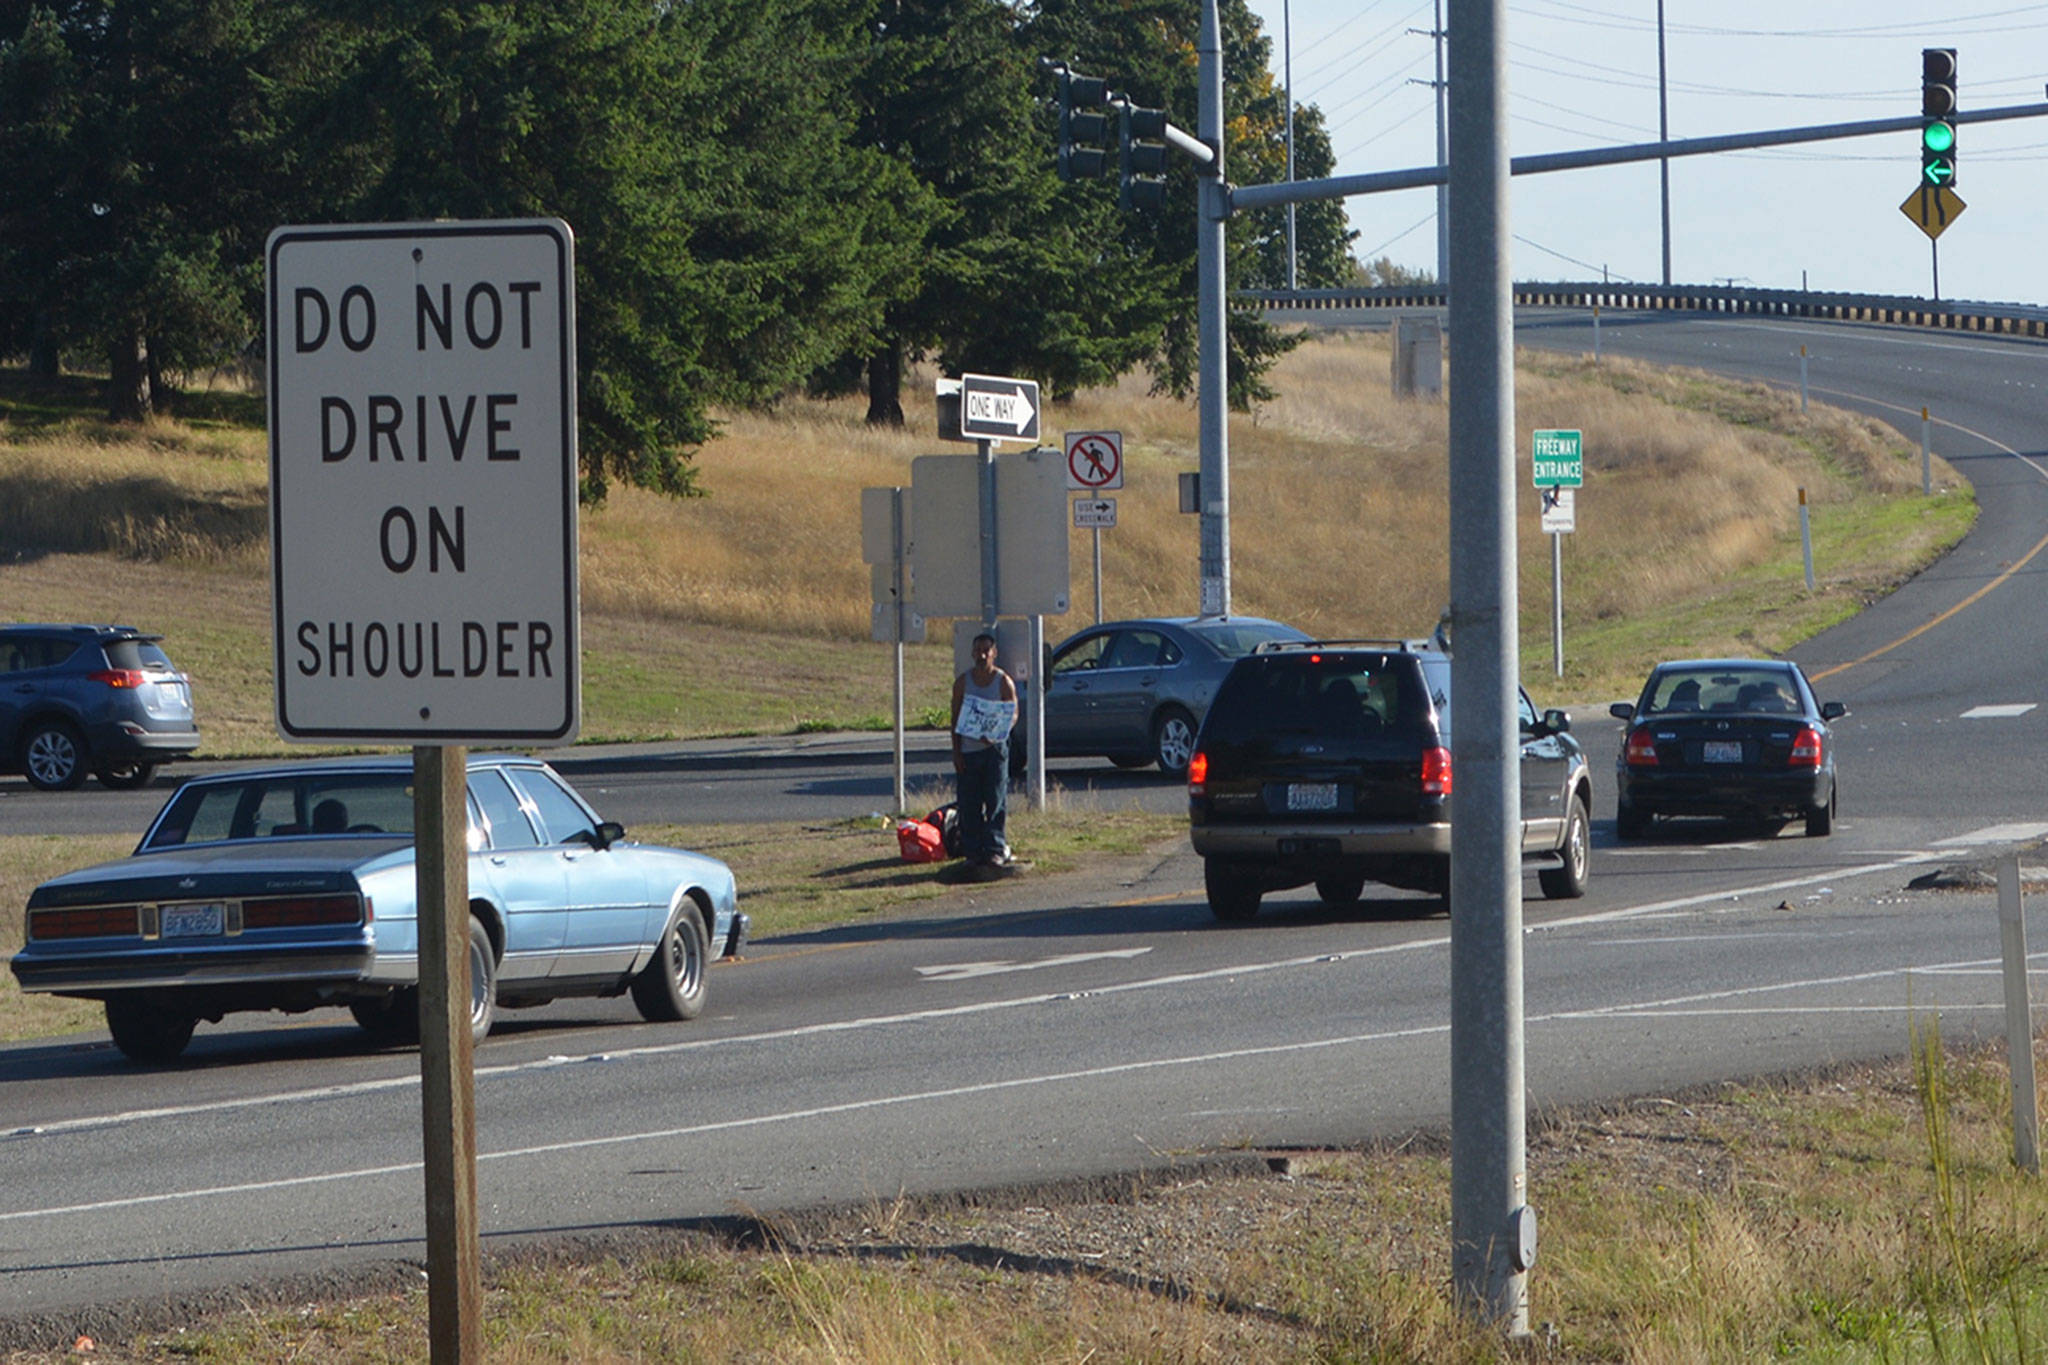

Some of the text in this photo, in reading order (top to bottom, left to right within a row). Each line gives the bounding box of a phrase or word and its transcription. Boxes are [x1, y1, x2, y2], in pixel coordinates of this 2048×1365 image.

[295, 282, 542, 353] DO NOT
[321, 394, 520, 463] DRIVE
[970, 395, 1016, 419] ONE WAY
[1535, 461, 1581, 478] ENTRANCE
[1536, 439, 1578, 456] FREEWAY
[380, 505, 466, 573] ON
[297, 621, 553, 679] SHOULDER
